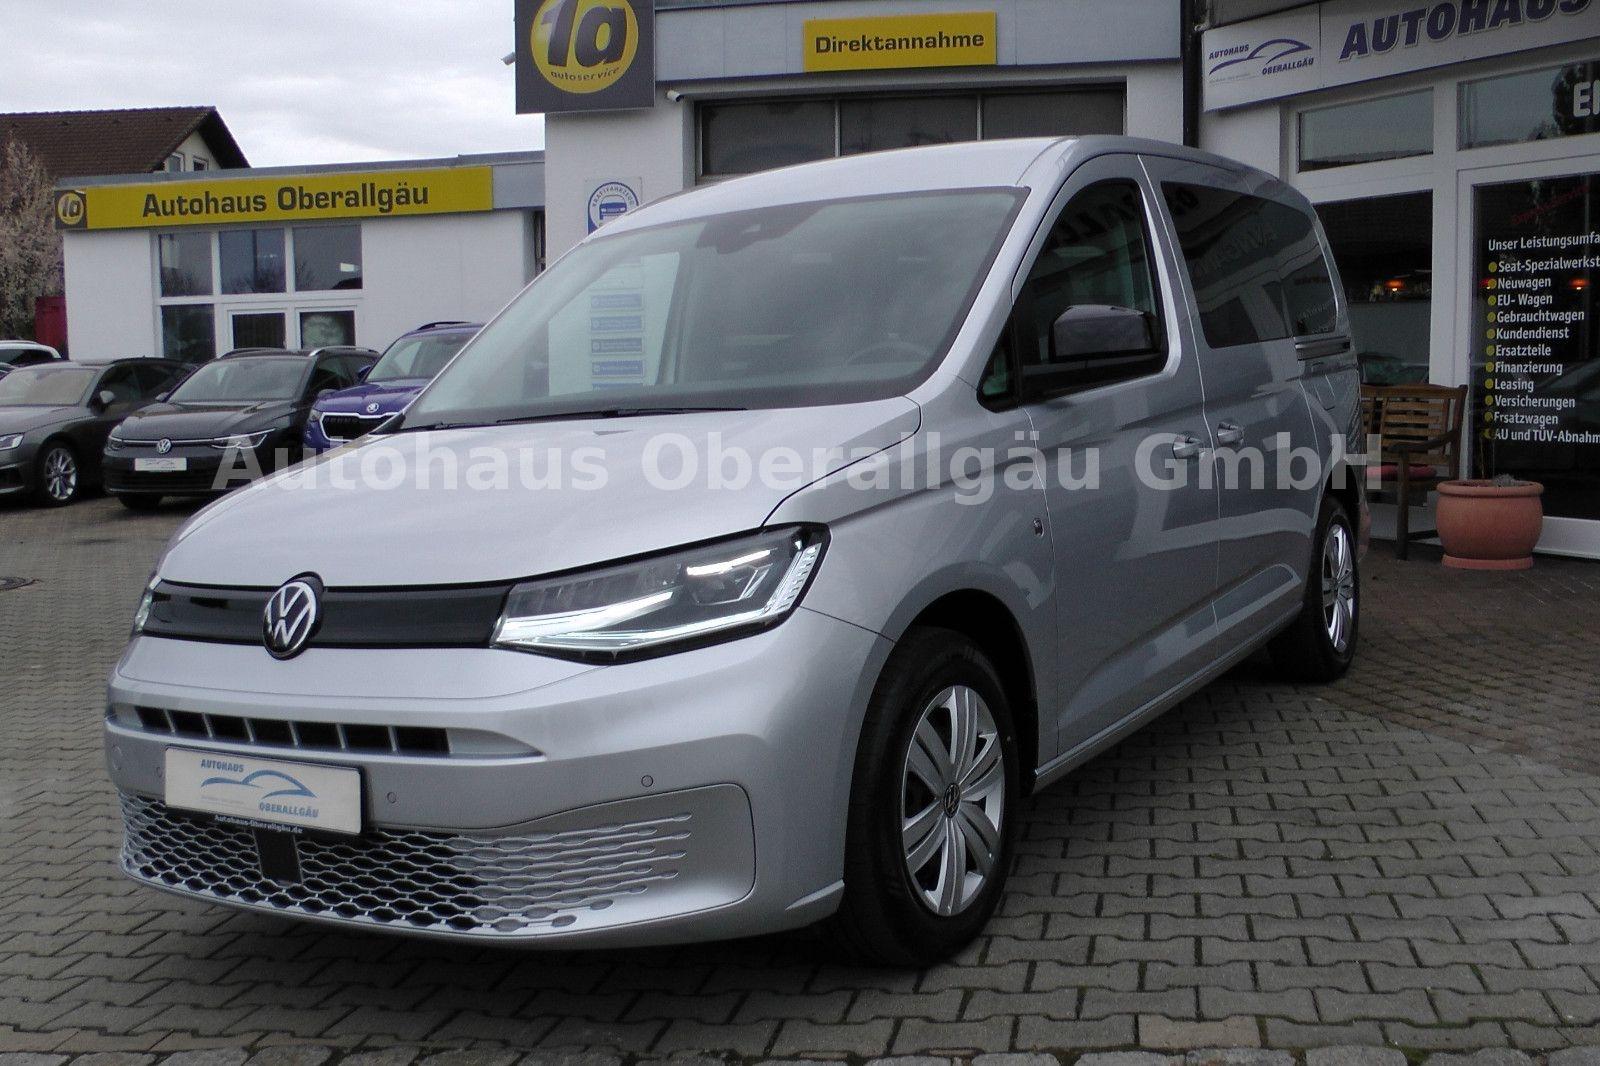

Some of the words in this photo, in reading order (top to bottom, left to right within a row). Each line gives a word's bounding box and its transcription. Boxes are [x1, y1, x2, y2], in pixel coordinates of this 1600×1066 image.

[815, 31, 985, 54] Direktannahme
[1208, 44, 1250, 60] AUTOHAUS
[1261, 56, 1315, 75] OBERALLGÄU
[551, 66, 620, 82] autoservice
[142, 191, 268, 218] Autohaus
[277, 181, 429, 214] Oberallgäu
[1488, 239, 1519, 251] Unser
[1498, 256, 1600, 273] Seat-Spezialwerkst
[1497, 277, 1551, 291] Neuwagen
[1497, 294, 1516, 306] EU-
[1518, 293, 1553, 308] Wagen
[1497, 309, 1585, 324] Gebrauchtwagen
[1496, 326, 1570, 340] Kundendienst
[1495, 343, 1552, 356] Ersatzteile
[1494, 360, 1563, 376] Finanzierung
[1494, 377, 1535, 393] Leasing
[1494, 395, 1576, 410] Versicherungen
[1510, 428, 1531, 441] und
[201, 759, 244, 772] AUTOHAUS
[259, 802, 318, 818] OBERALLGÄU
